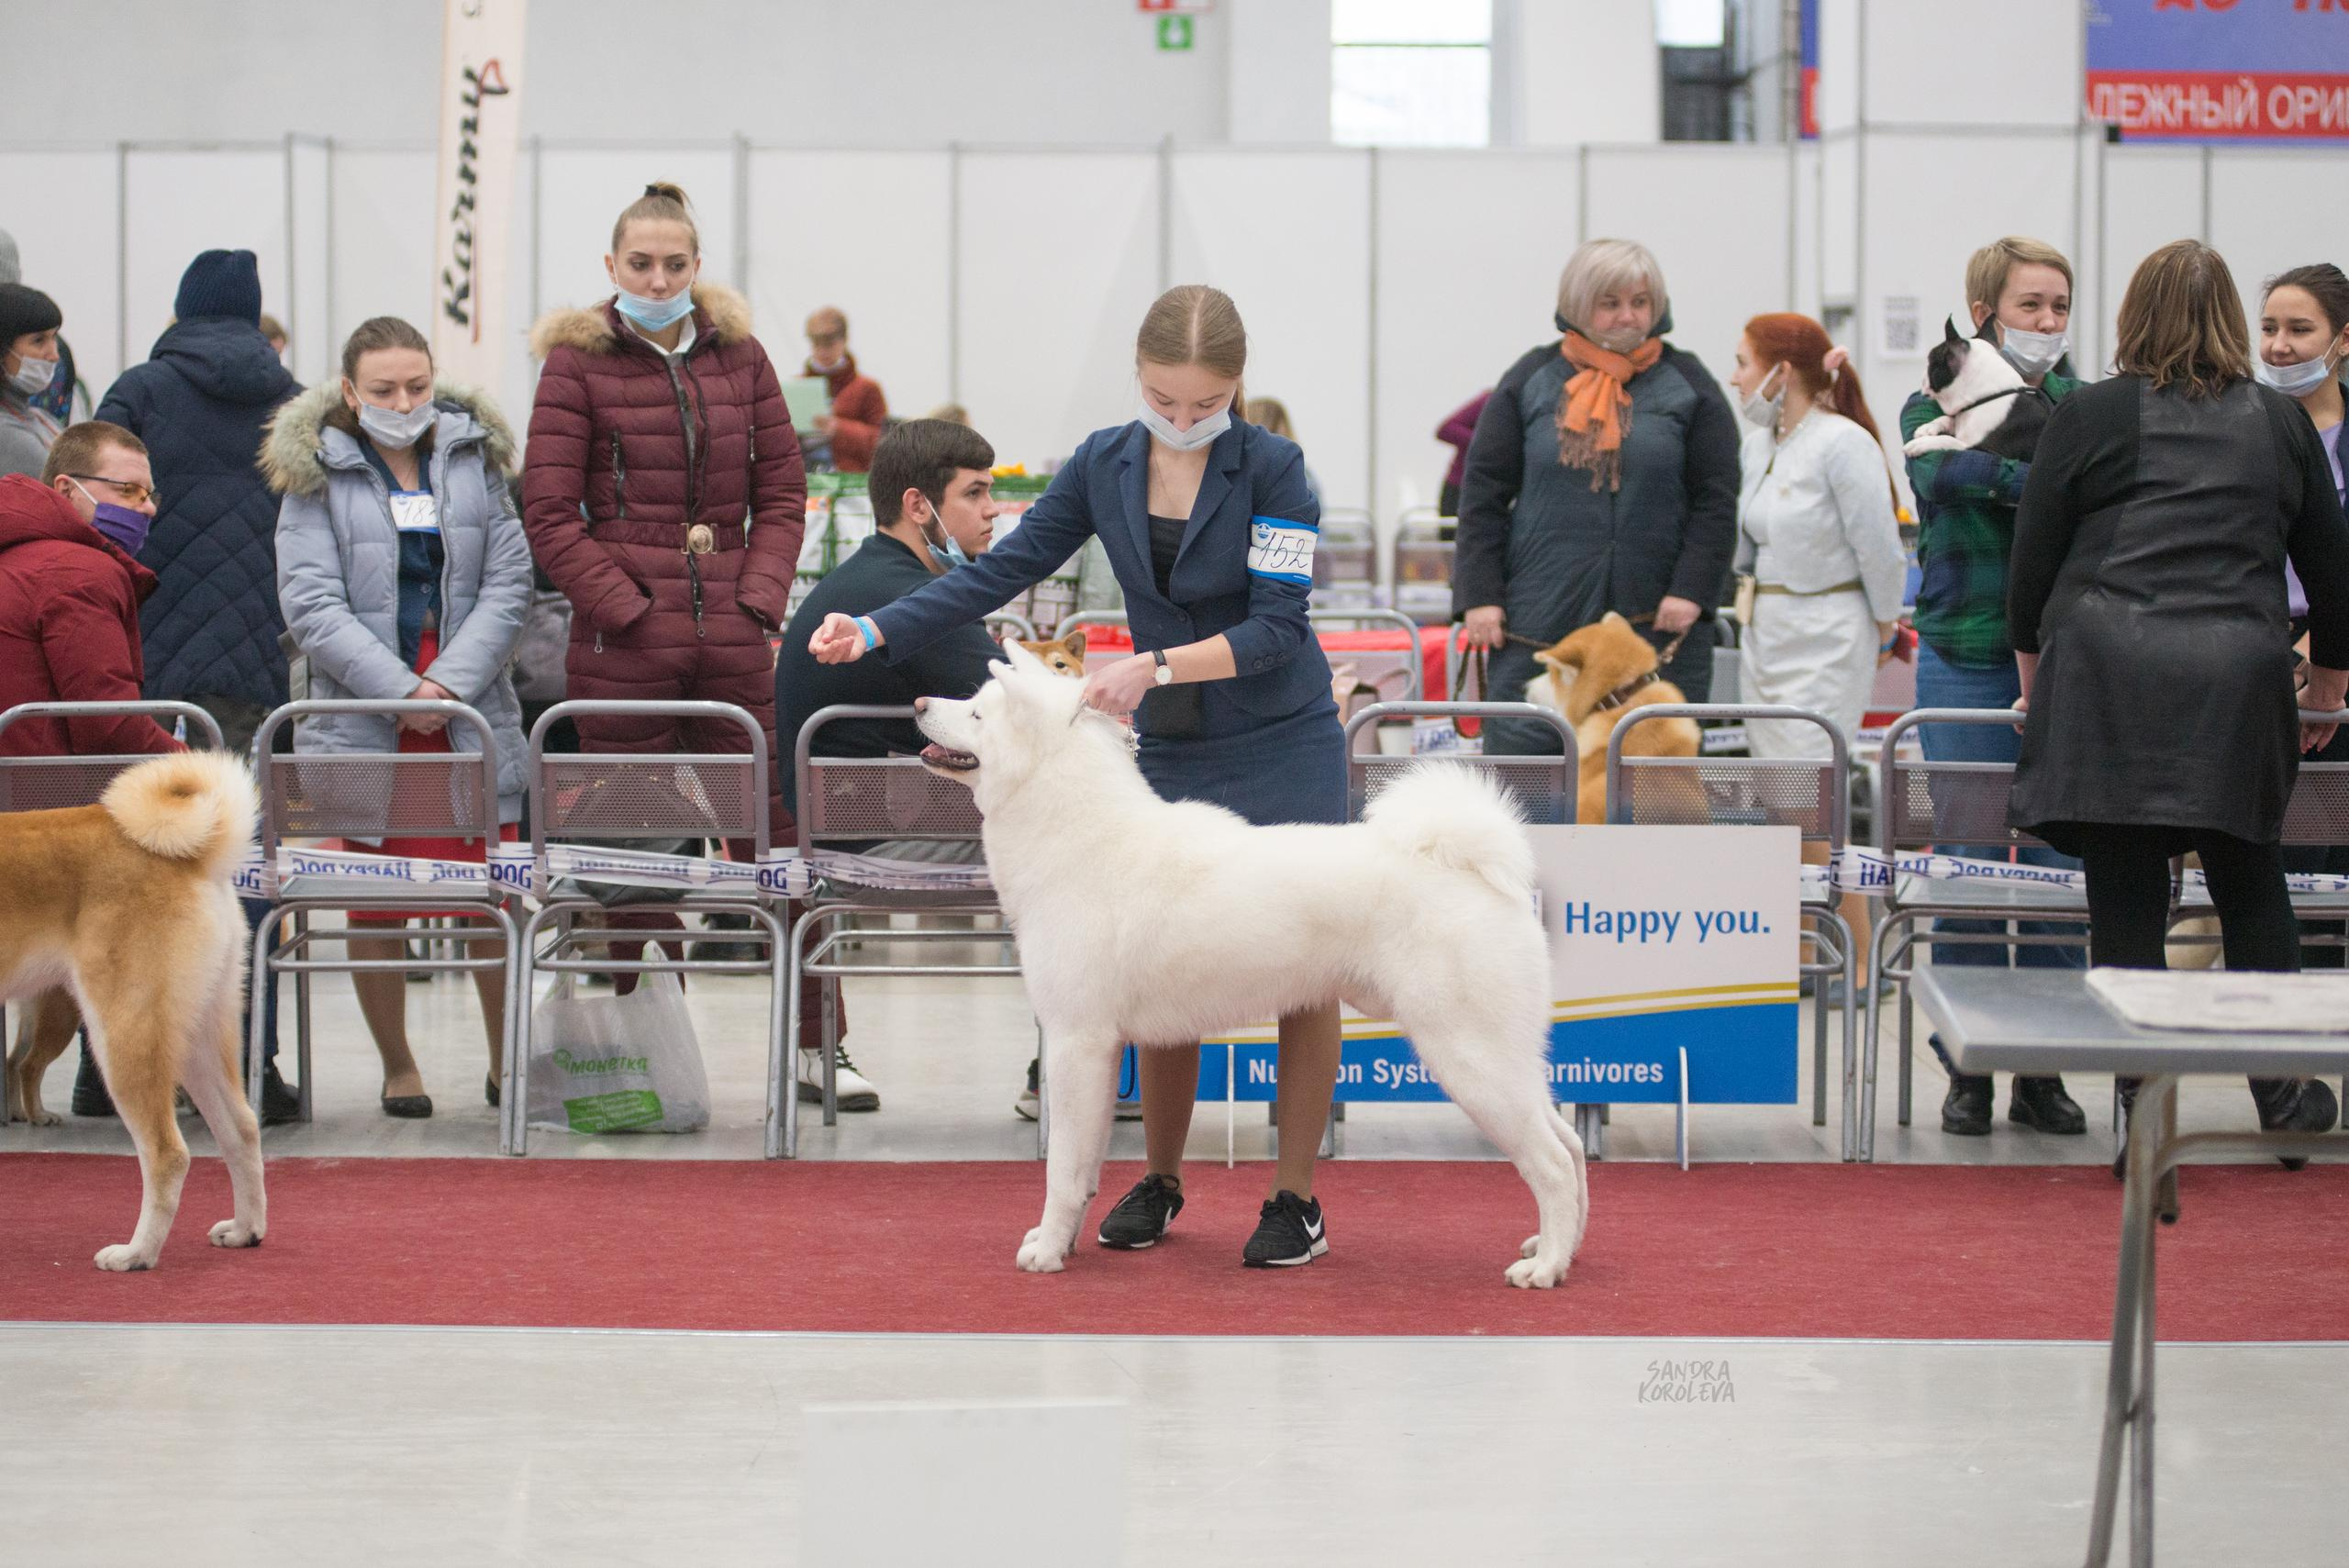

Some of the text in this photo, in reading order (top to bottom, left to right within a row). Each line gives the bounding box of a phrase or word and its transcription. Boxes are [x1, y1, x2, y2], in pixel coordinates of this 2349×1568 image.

[2087, 76, 2349, 129] ДЕЖНЫЙ ОРИ
[1258, 531, 1308, 569] 152
[490, 864, 532, 889] DOG
[756, 867, 787, 890] OG
[1565, 902, 1771, 943] Happy you.
[1543, 1057, 1664, 1084] arnivores
